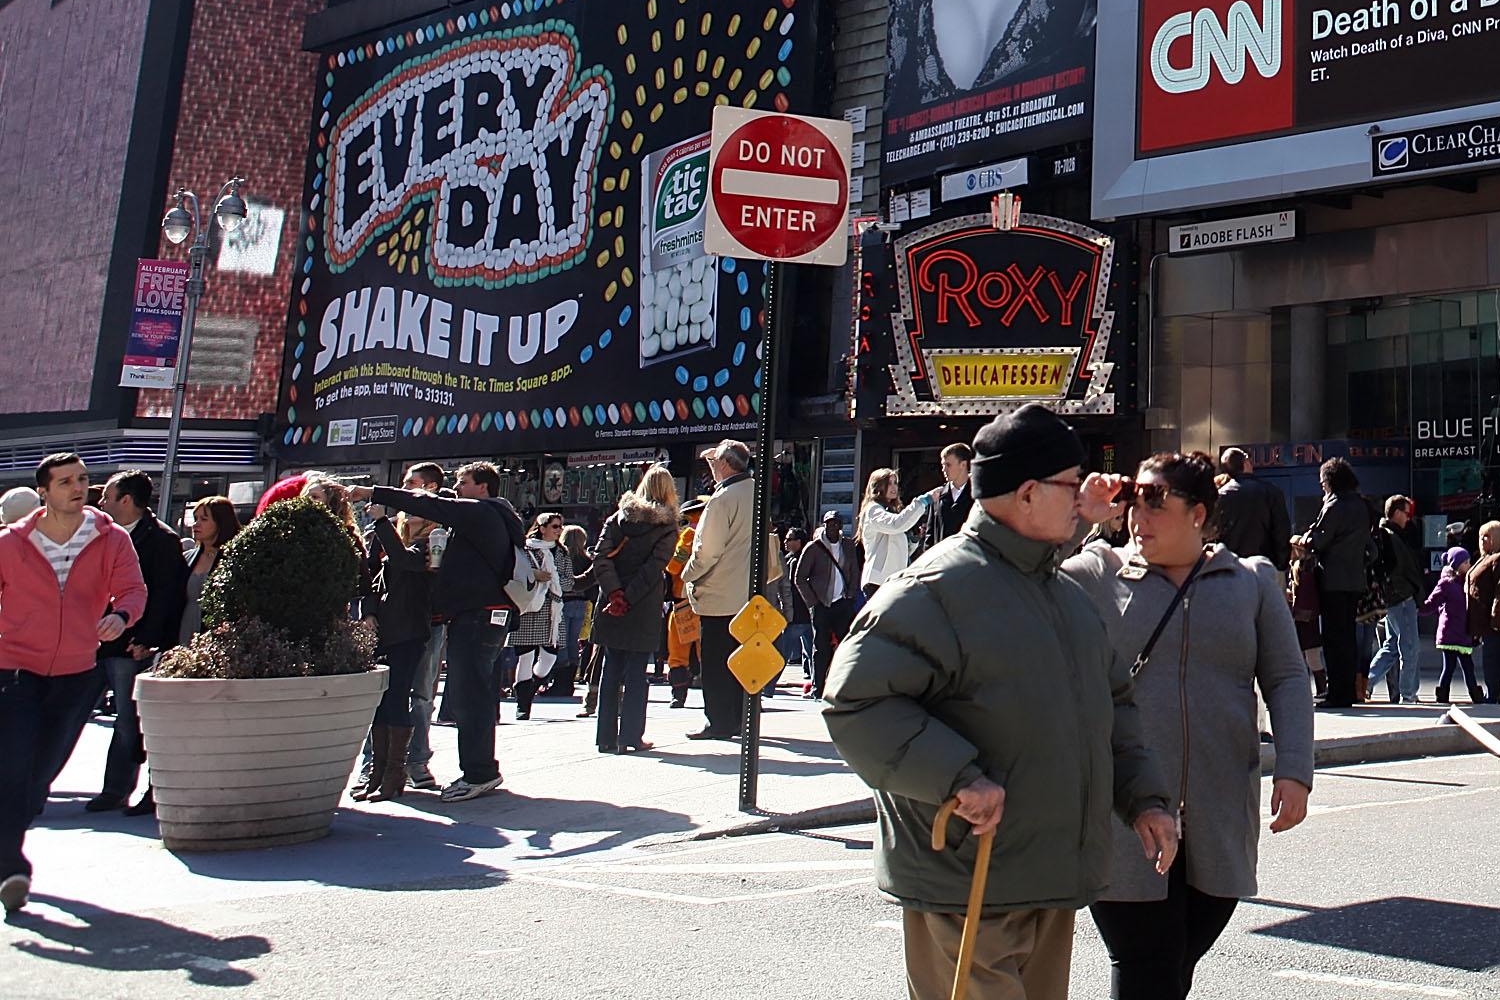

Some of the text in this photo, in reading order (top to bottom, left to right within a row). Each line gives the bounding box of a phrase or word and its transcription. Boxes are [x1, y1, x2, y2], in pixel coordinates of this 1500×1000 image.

[1311, 45, 1348, 63] Watch
[1351, 37, 1387, 56] Death
[1390, 34, 1403, 48] of
[1417, 28, 1449, 44] Diva,
[1452, 19, 1482, 37] CNN
[1311, 68, 1330, 82] ET.
[886, 141, 936, 163] TELECHARGE.COM
[957, 126, 990, 143] 239-6200
[995, 102, 1085, 136] CHICAGOTHEMUSICAL.COM
[915, 94, 1057, 142] AMBASSADOR THEATRE, BROADWAY
[338, 45, 567, 252] EVERY
[739, 139, 770, 164] DO
[781, 144, 825, 169] NOT
[436, 83, 607, 268] DAY
[673, 164, 702, 195] tic
[664, 188, 701, 219] tac
[741, 205, 816, 232] ENTER
[660, 230, 703, 255] freshmints
[1194, 225, 1273, 246] ADOBE FLASH
[139, 272, 185, 292] FREE
[154, 266, 187, 275] FEBRUARY
[137, 290, 184, 310] LOVE
[919, 249, 1087, 327] ROXY
[313, 286, 452, 375] SHAKE
[459, 308, 499, 366] IT
[313, 363, 573, 395] Interact this billboard through the Tic Tac Times Square app.
[941, 364, 1063, 387] DELICATESSEN
[315, 382, 455, 410] To get the text 313131.
[1418, 417, 1473, 439] BLUE
[1415, 446, 1476, 458] BREAKFAST
